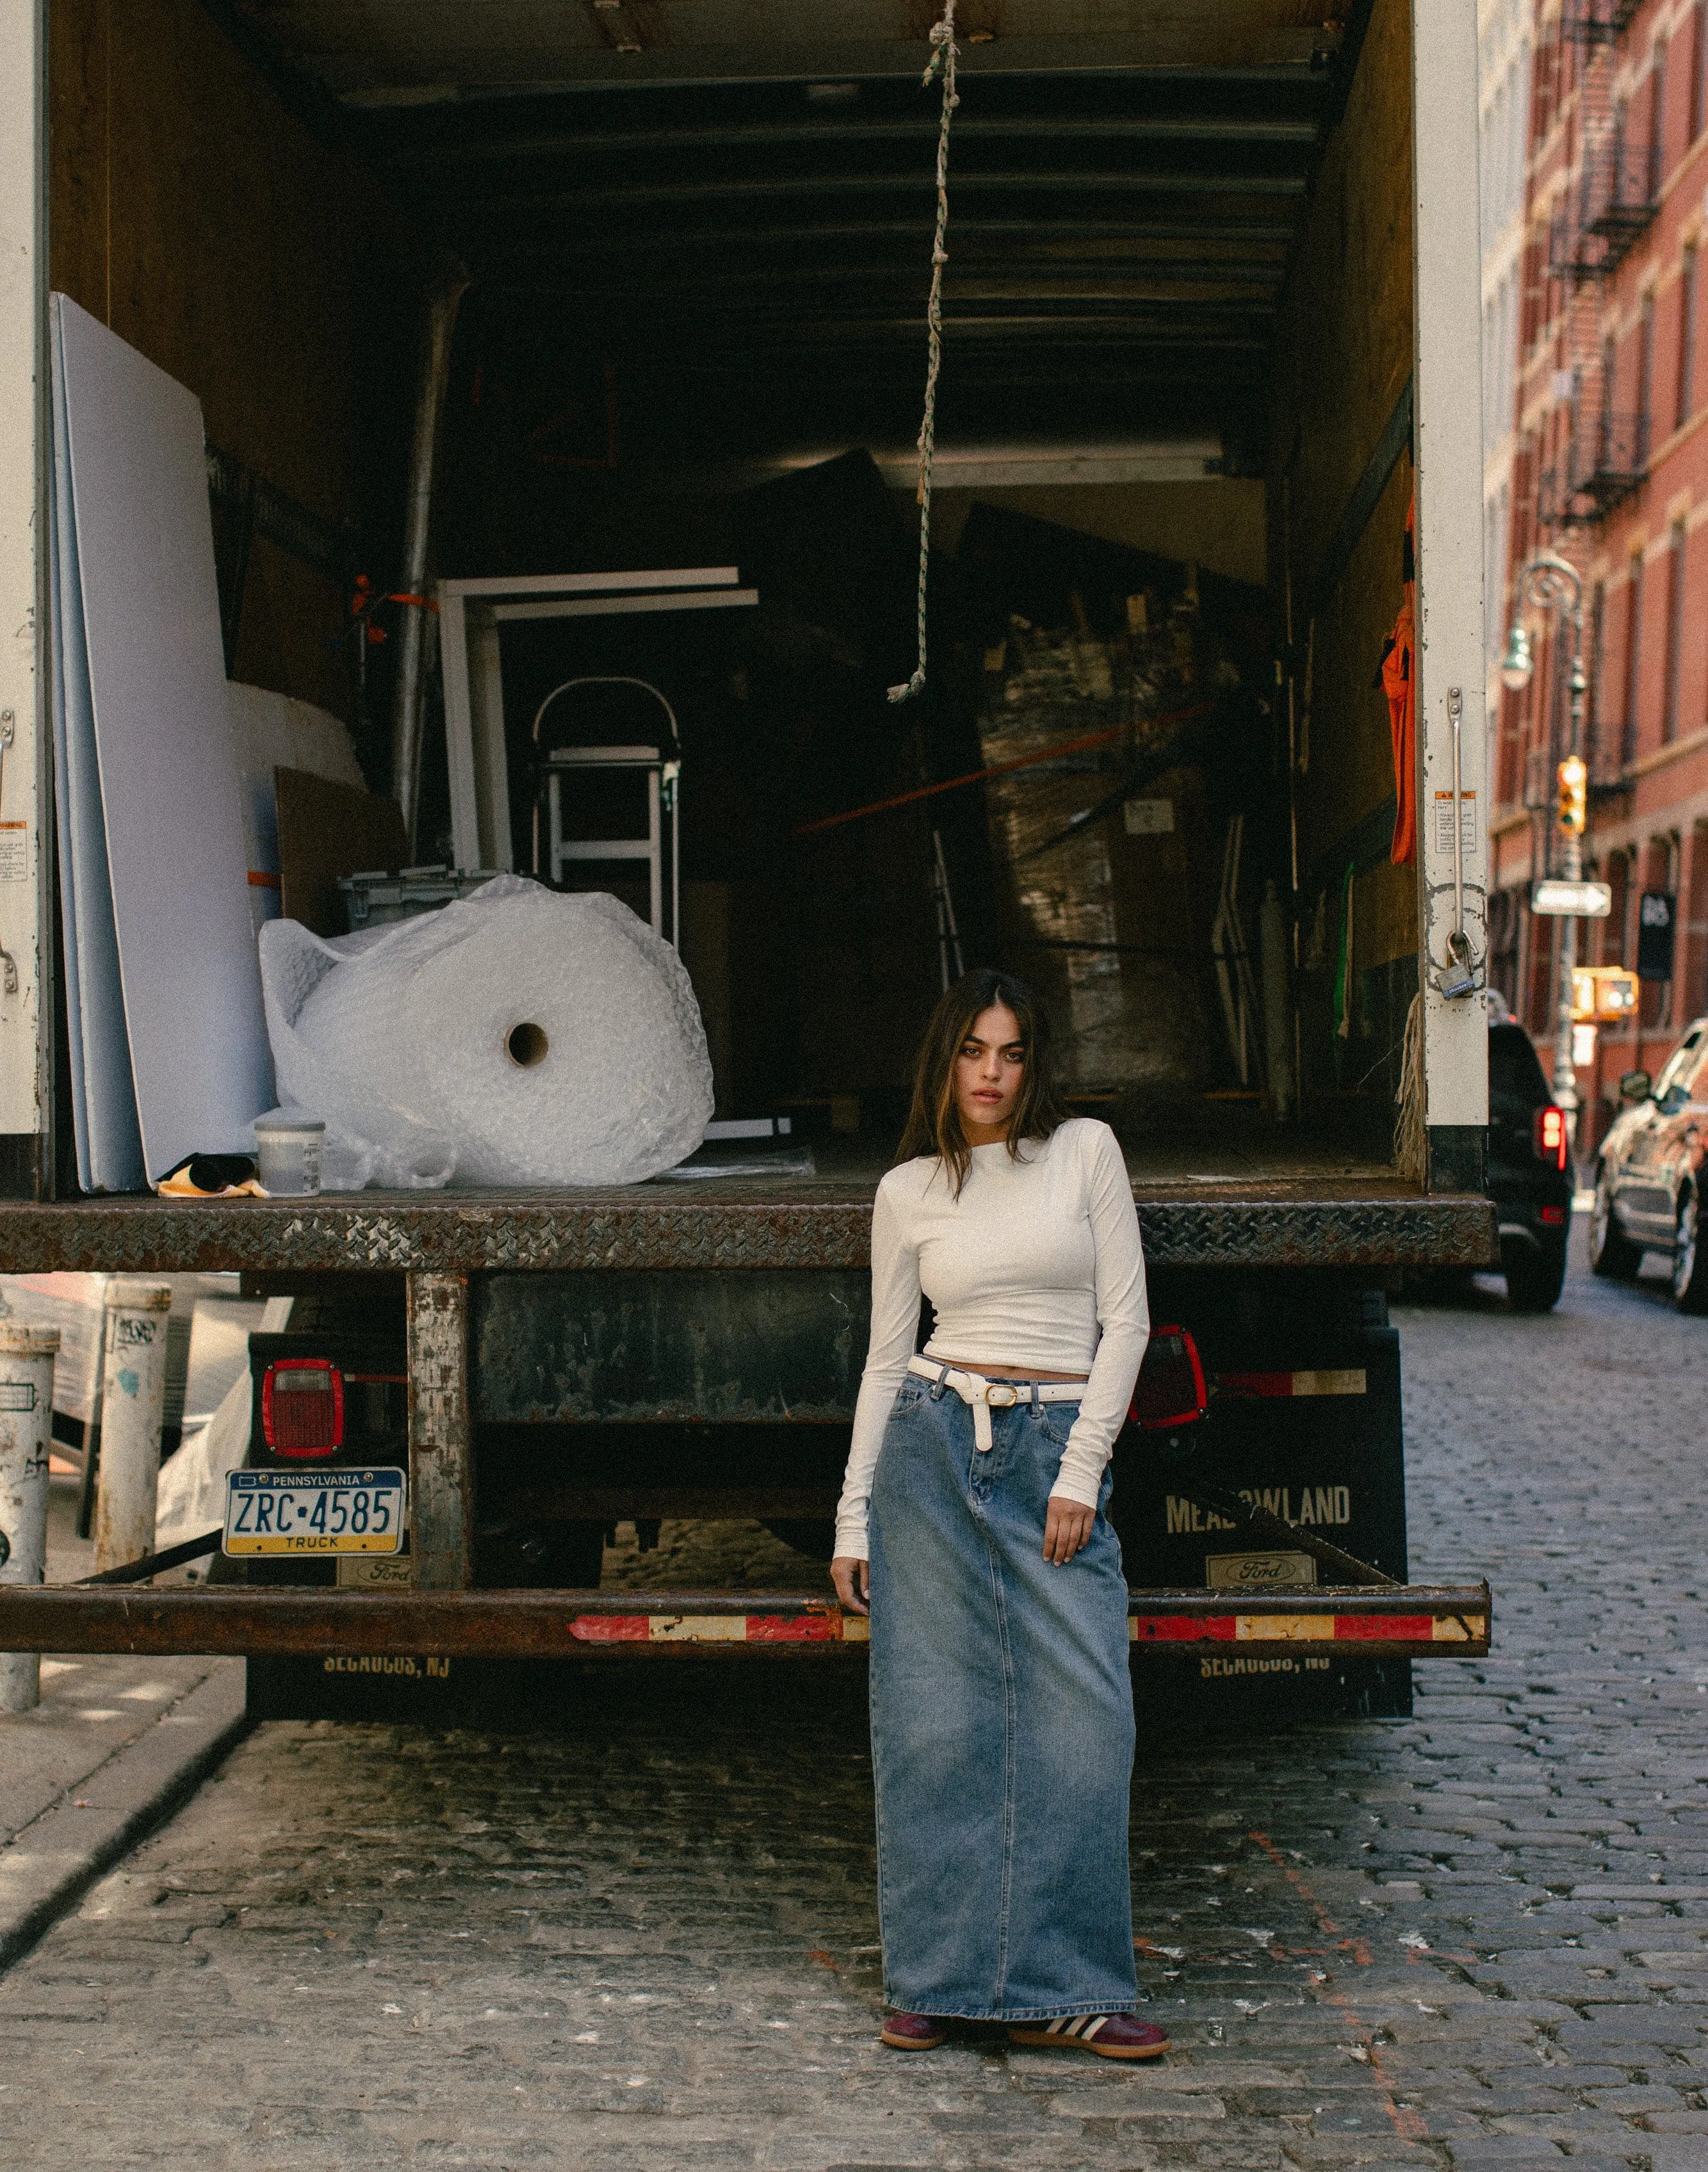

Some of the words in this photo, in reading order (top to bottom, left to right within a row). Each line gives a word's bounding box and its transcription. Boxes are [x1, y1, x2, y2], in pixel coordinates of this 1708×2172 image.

[273, 1475, 360, 1486] PENNSYLVANIA
[286, 1537, 338, 1548] TRUCK
[1239, 1560, 1281, 1579] Ford
